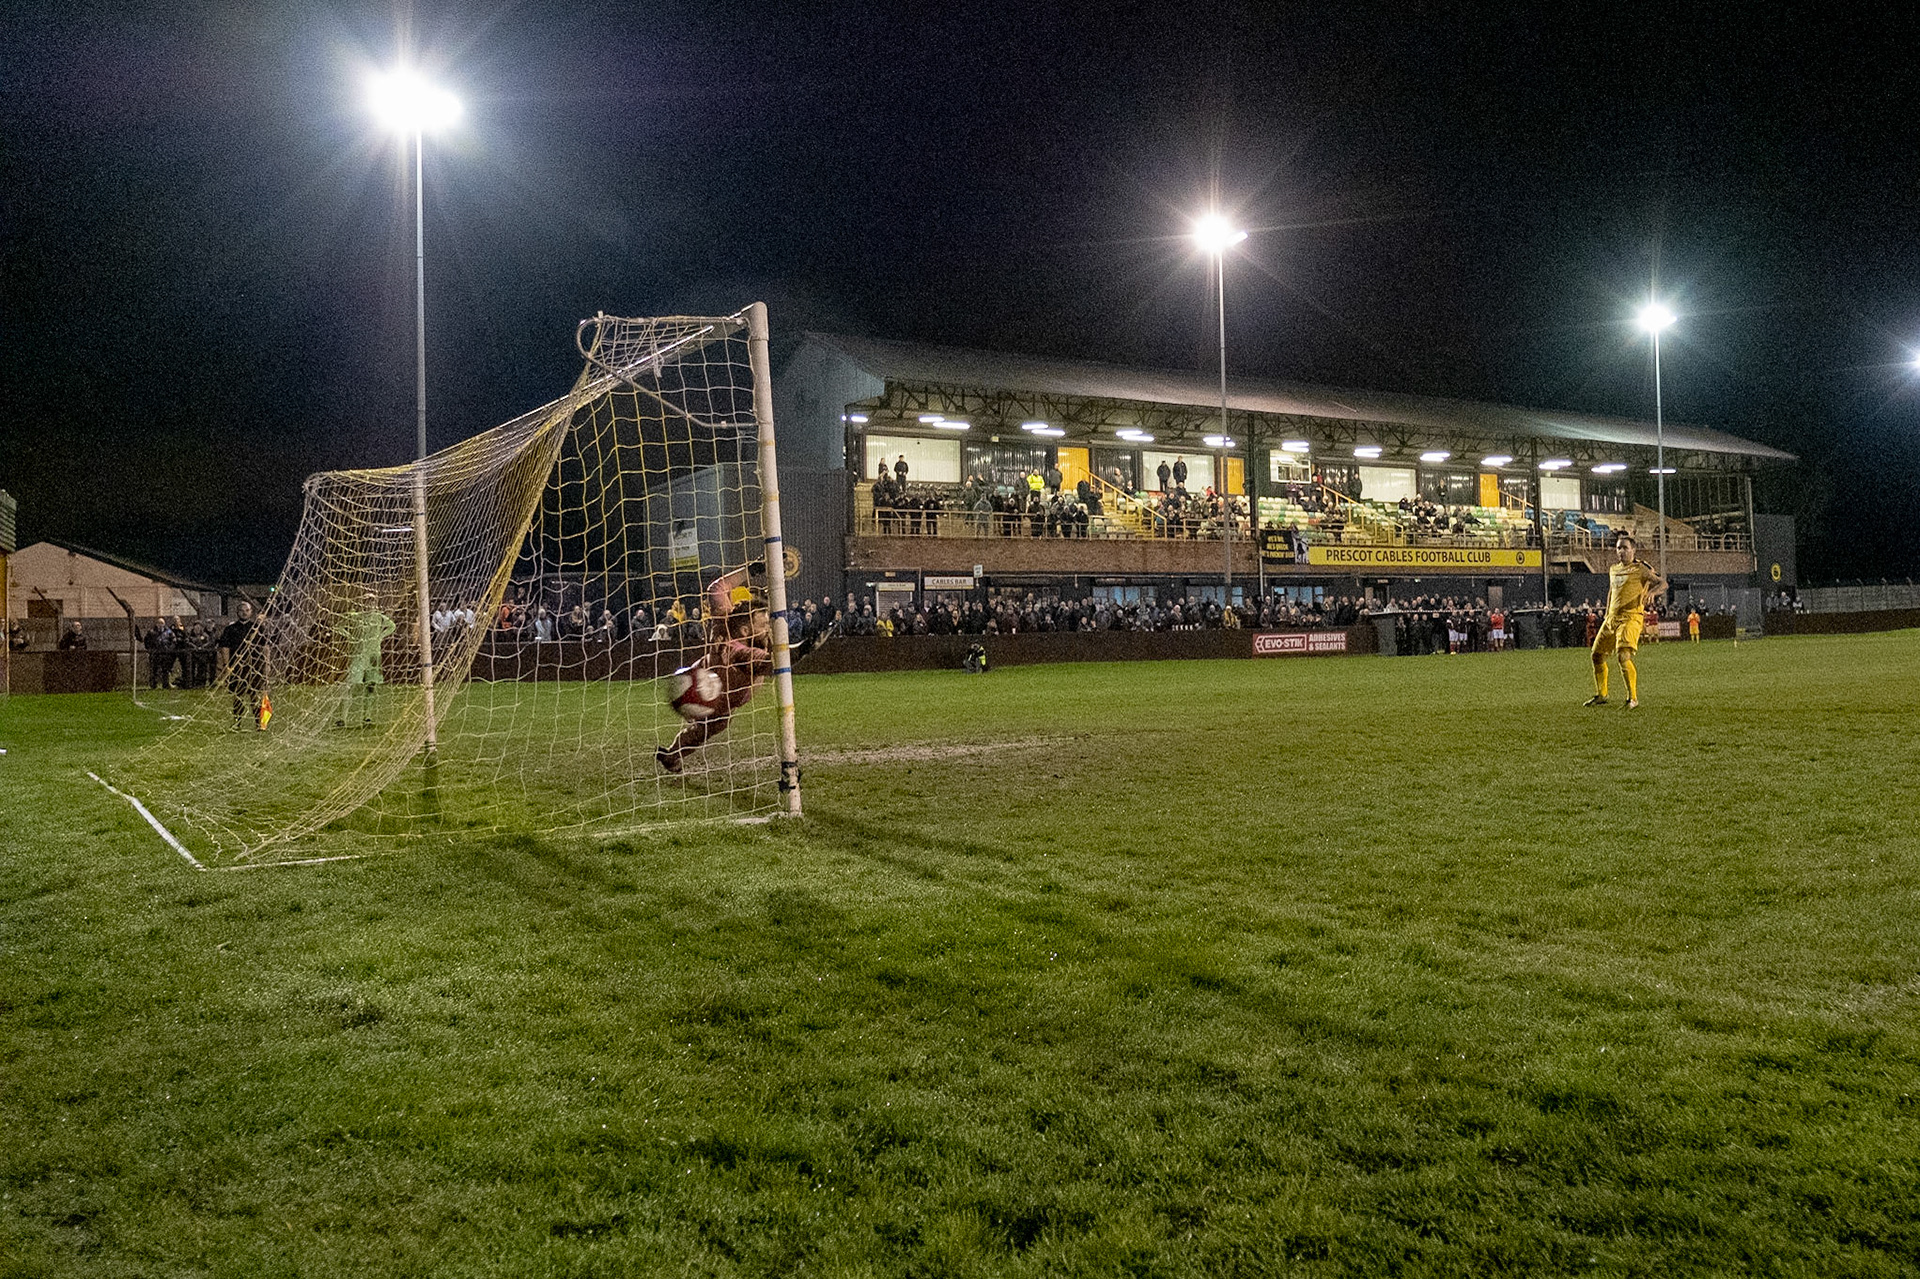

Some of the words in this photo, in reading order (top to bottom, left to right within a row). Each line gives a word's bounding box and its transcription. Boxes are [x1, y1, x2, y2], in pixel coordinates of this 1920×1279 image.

[1326, 549, 1373, 561] PRESCOT
[1375, 550, 1413, 562] CABLES
[1415, 551, 1465, 562] FOOTBALL
[1467, 551, 1491, 563] CLUB
[1309, 633, 1346, 642] ADHESIVES
[1309, 642, 1314, 650] &
[1315, 642, 1346, 650] SEALANTS
